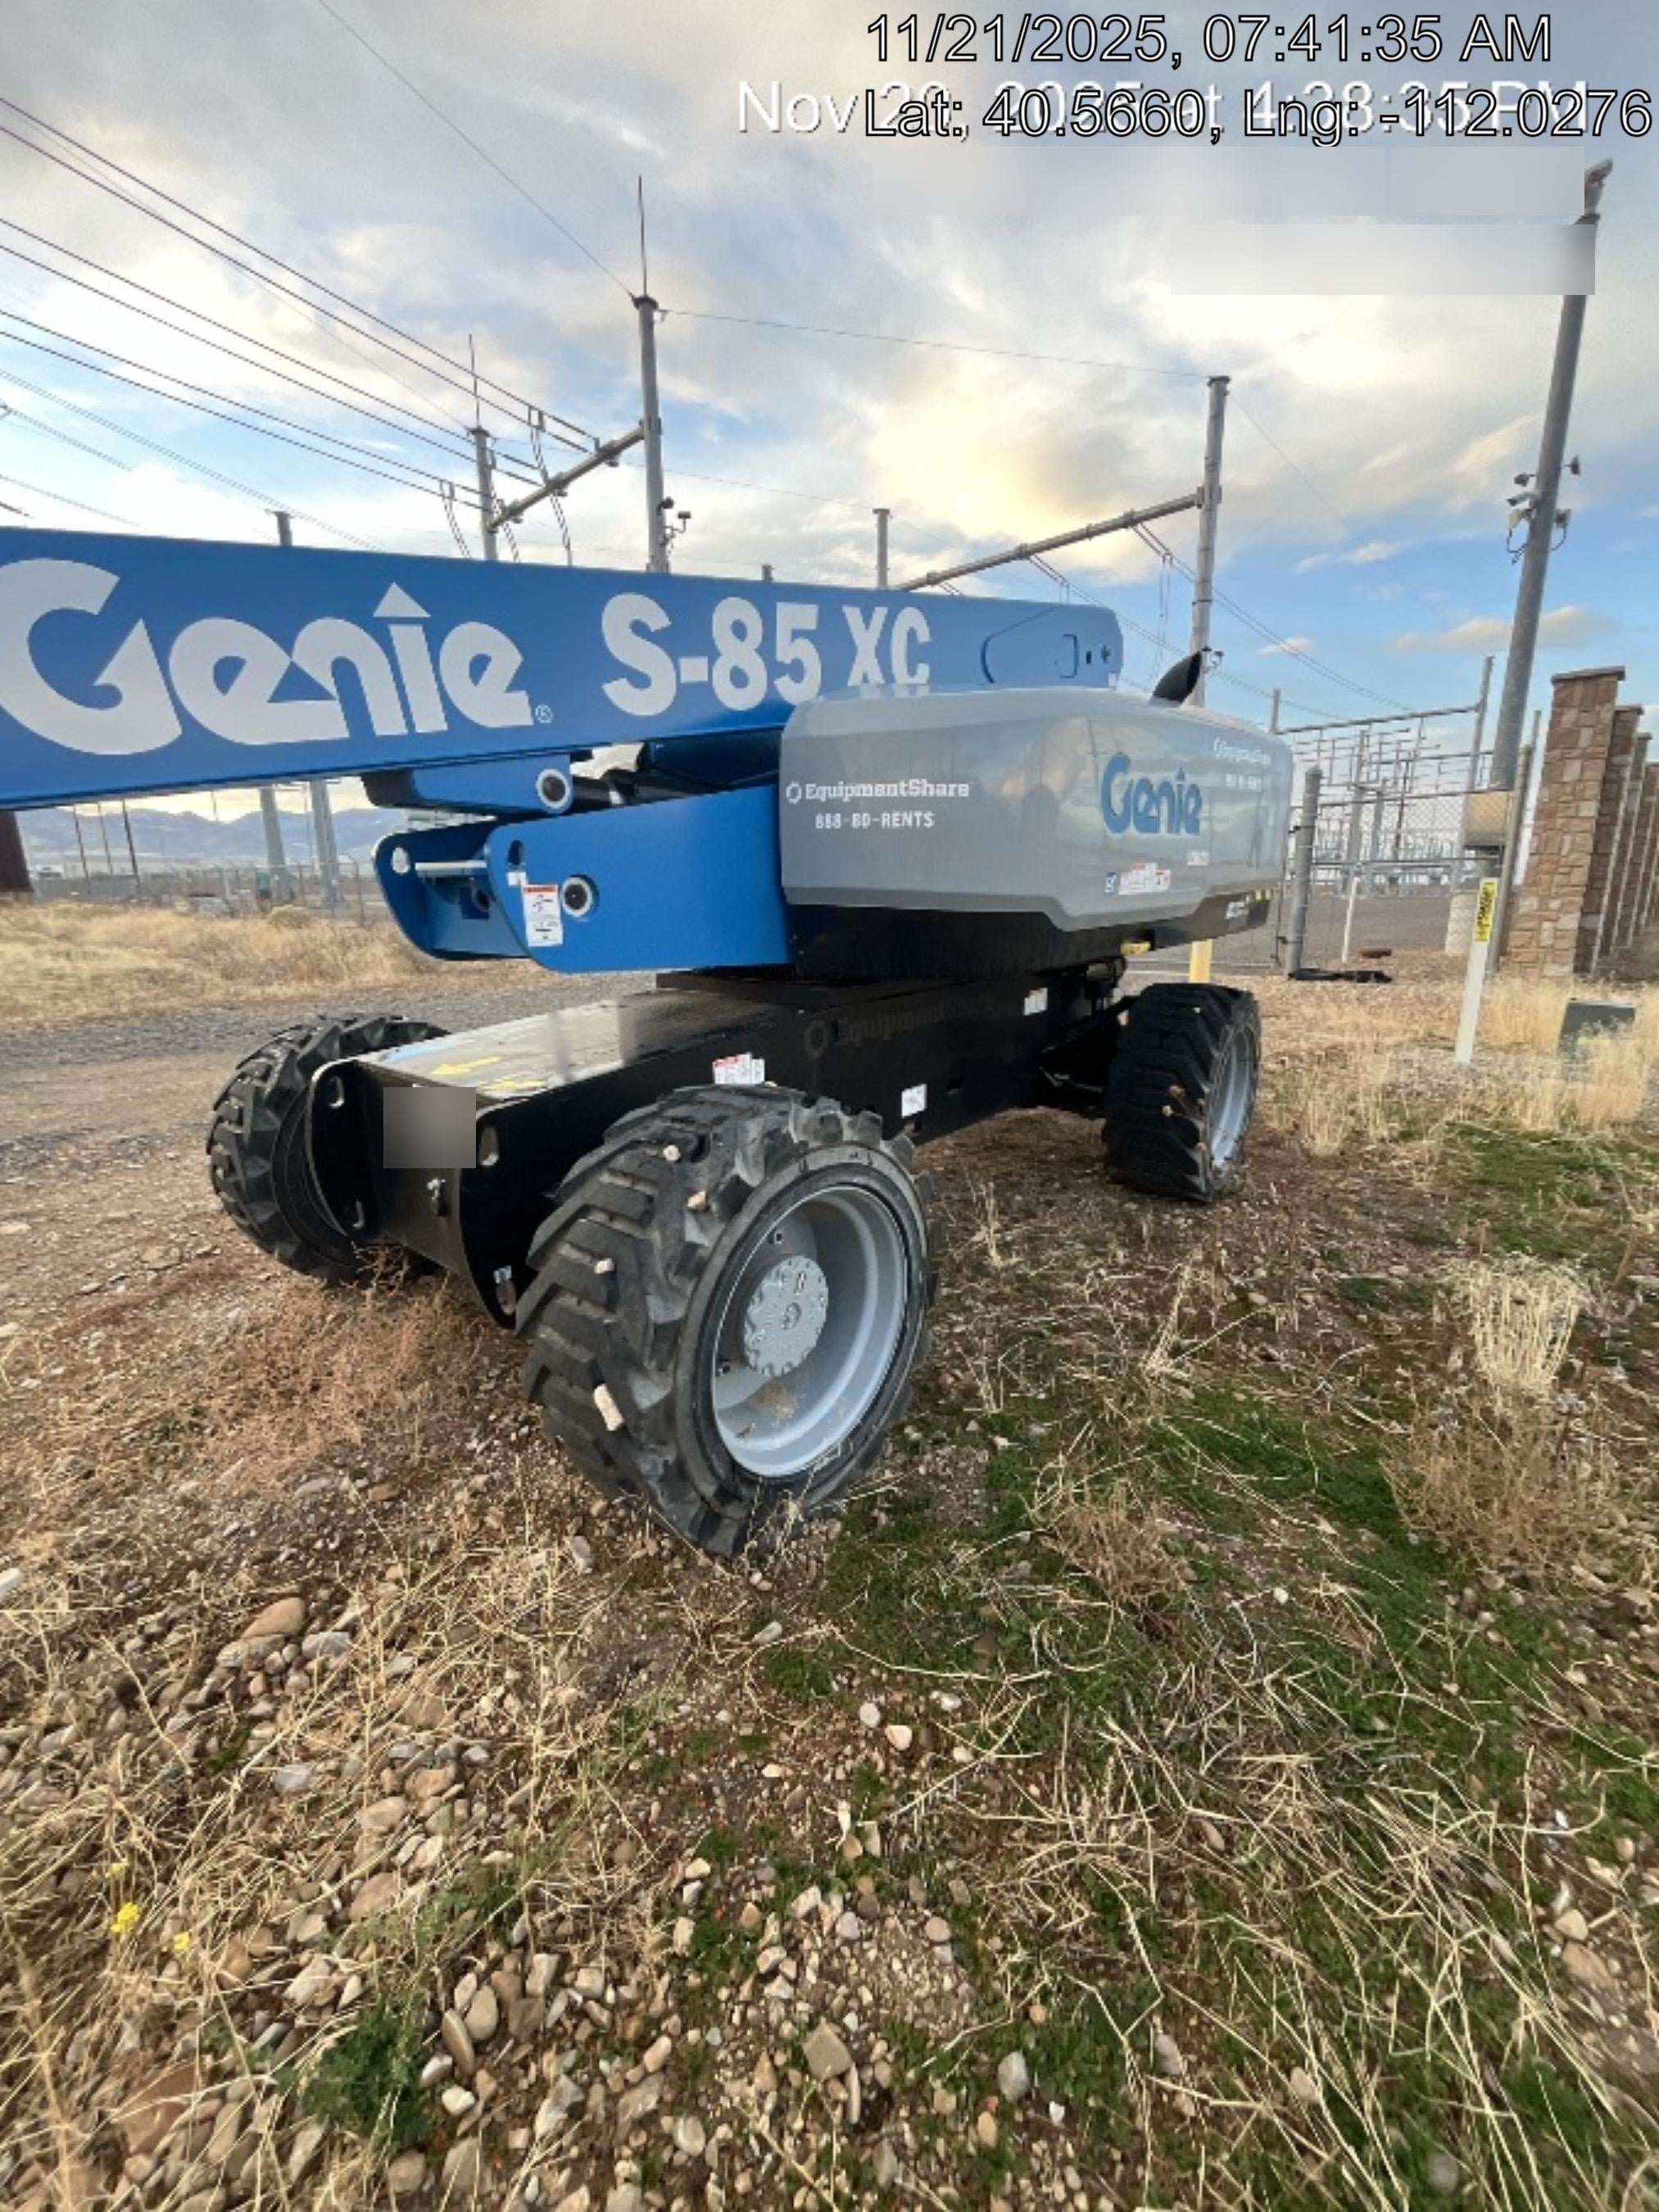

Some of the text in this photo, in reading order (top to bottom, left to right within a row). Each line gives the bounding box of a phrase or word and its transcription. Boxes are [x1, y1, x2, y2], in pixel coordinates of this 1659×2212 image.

[0, 558, 931, 755] Genie S-85 XC
[805, 779, 970, 803] EquipmentShare
[1101, 751, 1203, 836] Genie
